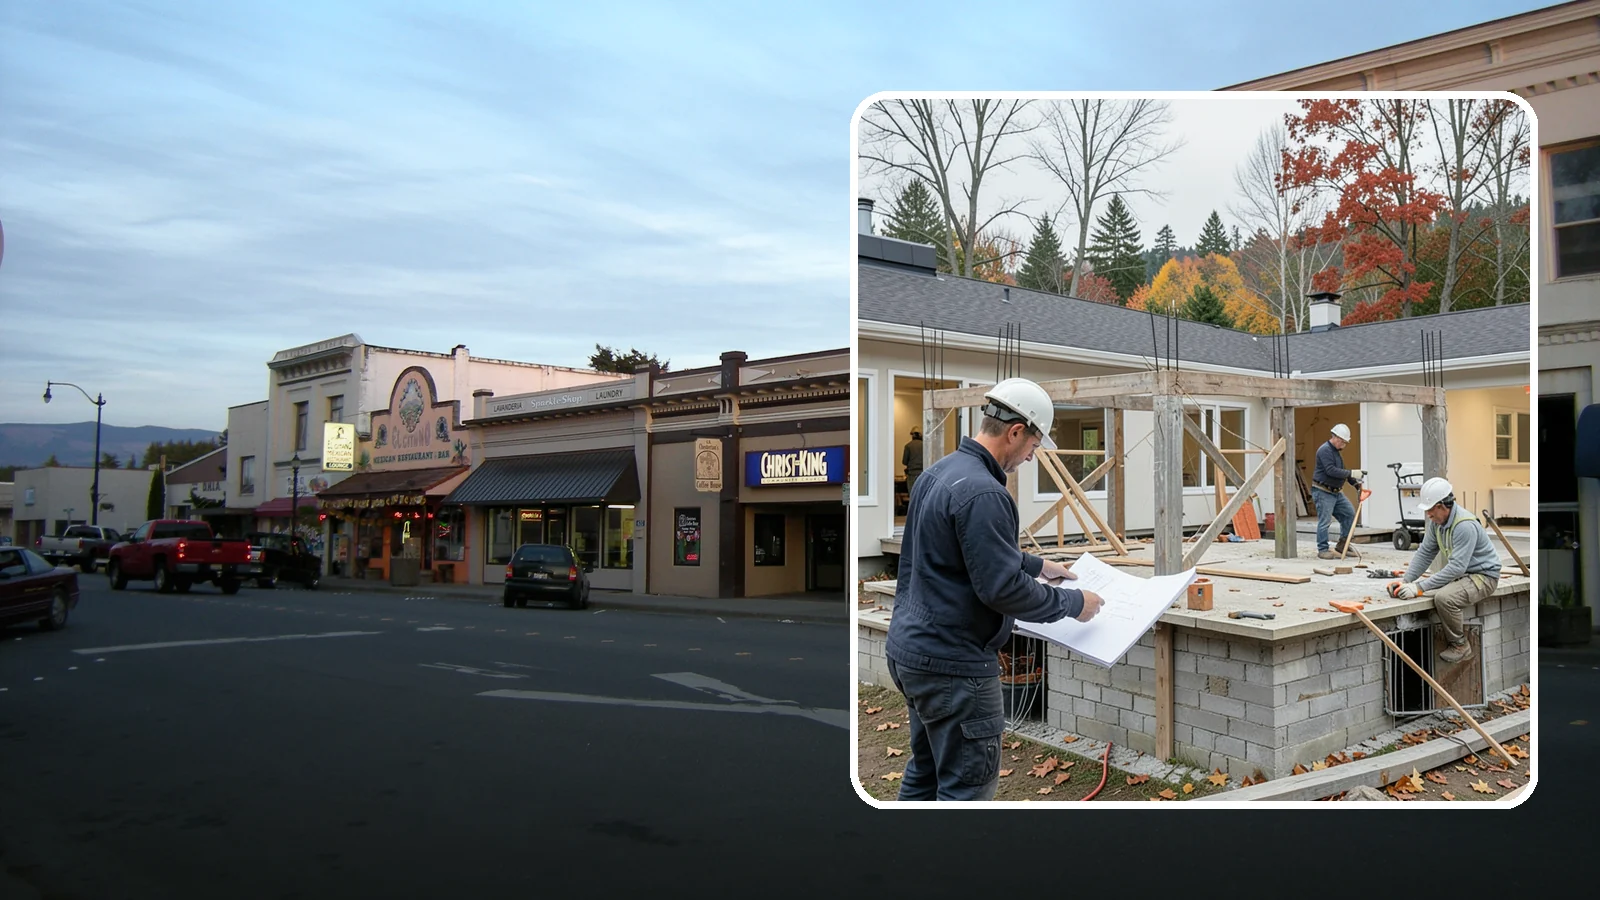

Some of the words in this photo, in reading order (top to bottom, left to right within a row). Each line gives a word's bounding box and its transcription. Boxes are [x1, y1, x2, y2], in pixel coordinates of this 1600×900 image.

[595, 389, 623, 400] LAUNDRY
[493, 402, 522, 412] LAVANDERIA
[531, 396, 561, 408] Sparkle
[561, 394, 582, 404] Shop
[398, 451, 433, 462] RESTAURANT
[438, 450, 450, 459] BAR
[761, 452, 798, 478] CHRIST
[799, 450, 827, 476] KING
